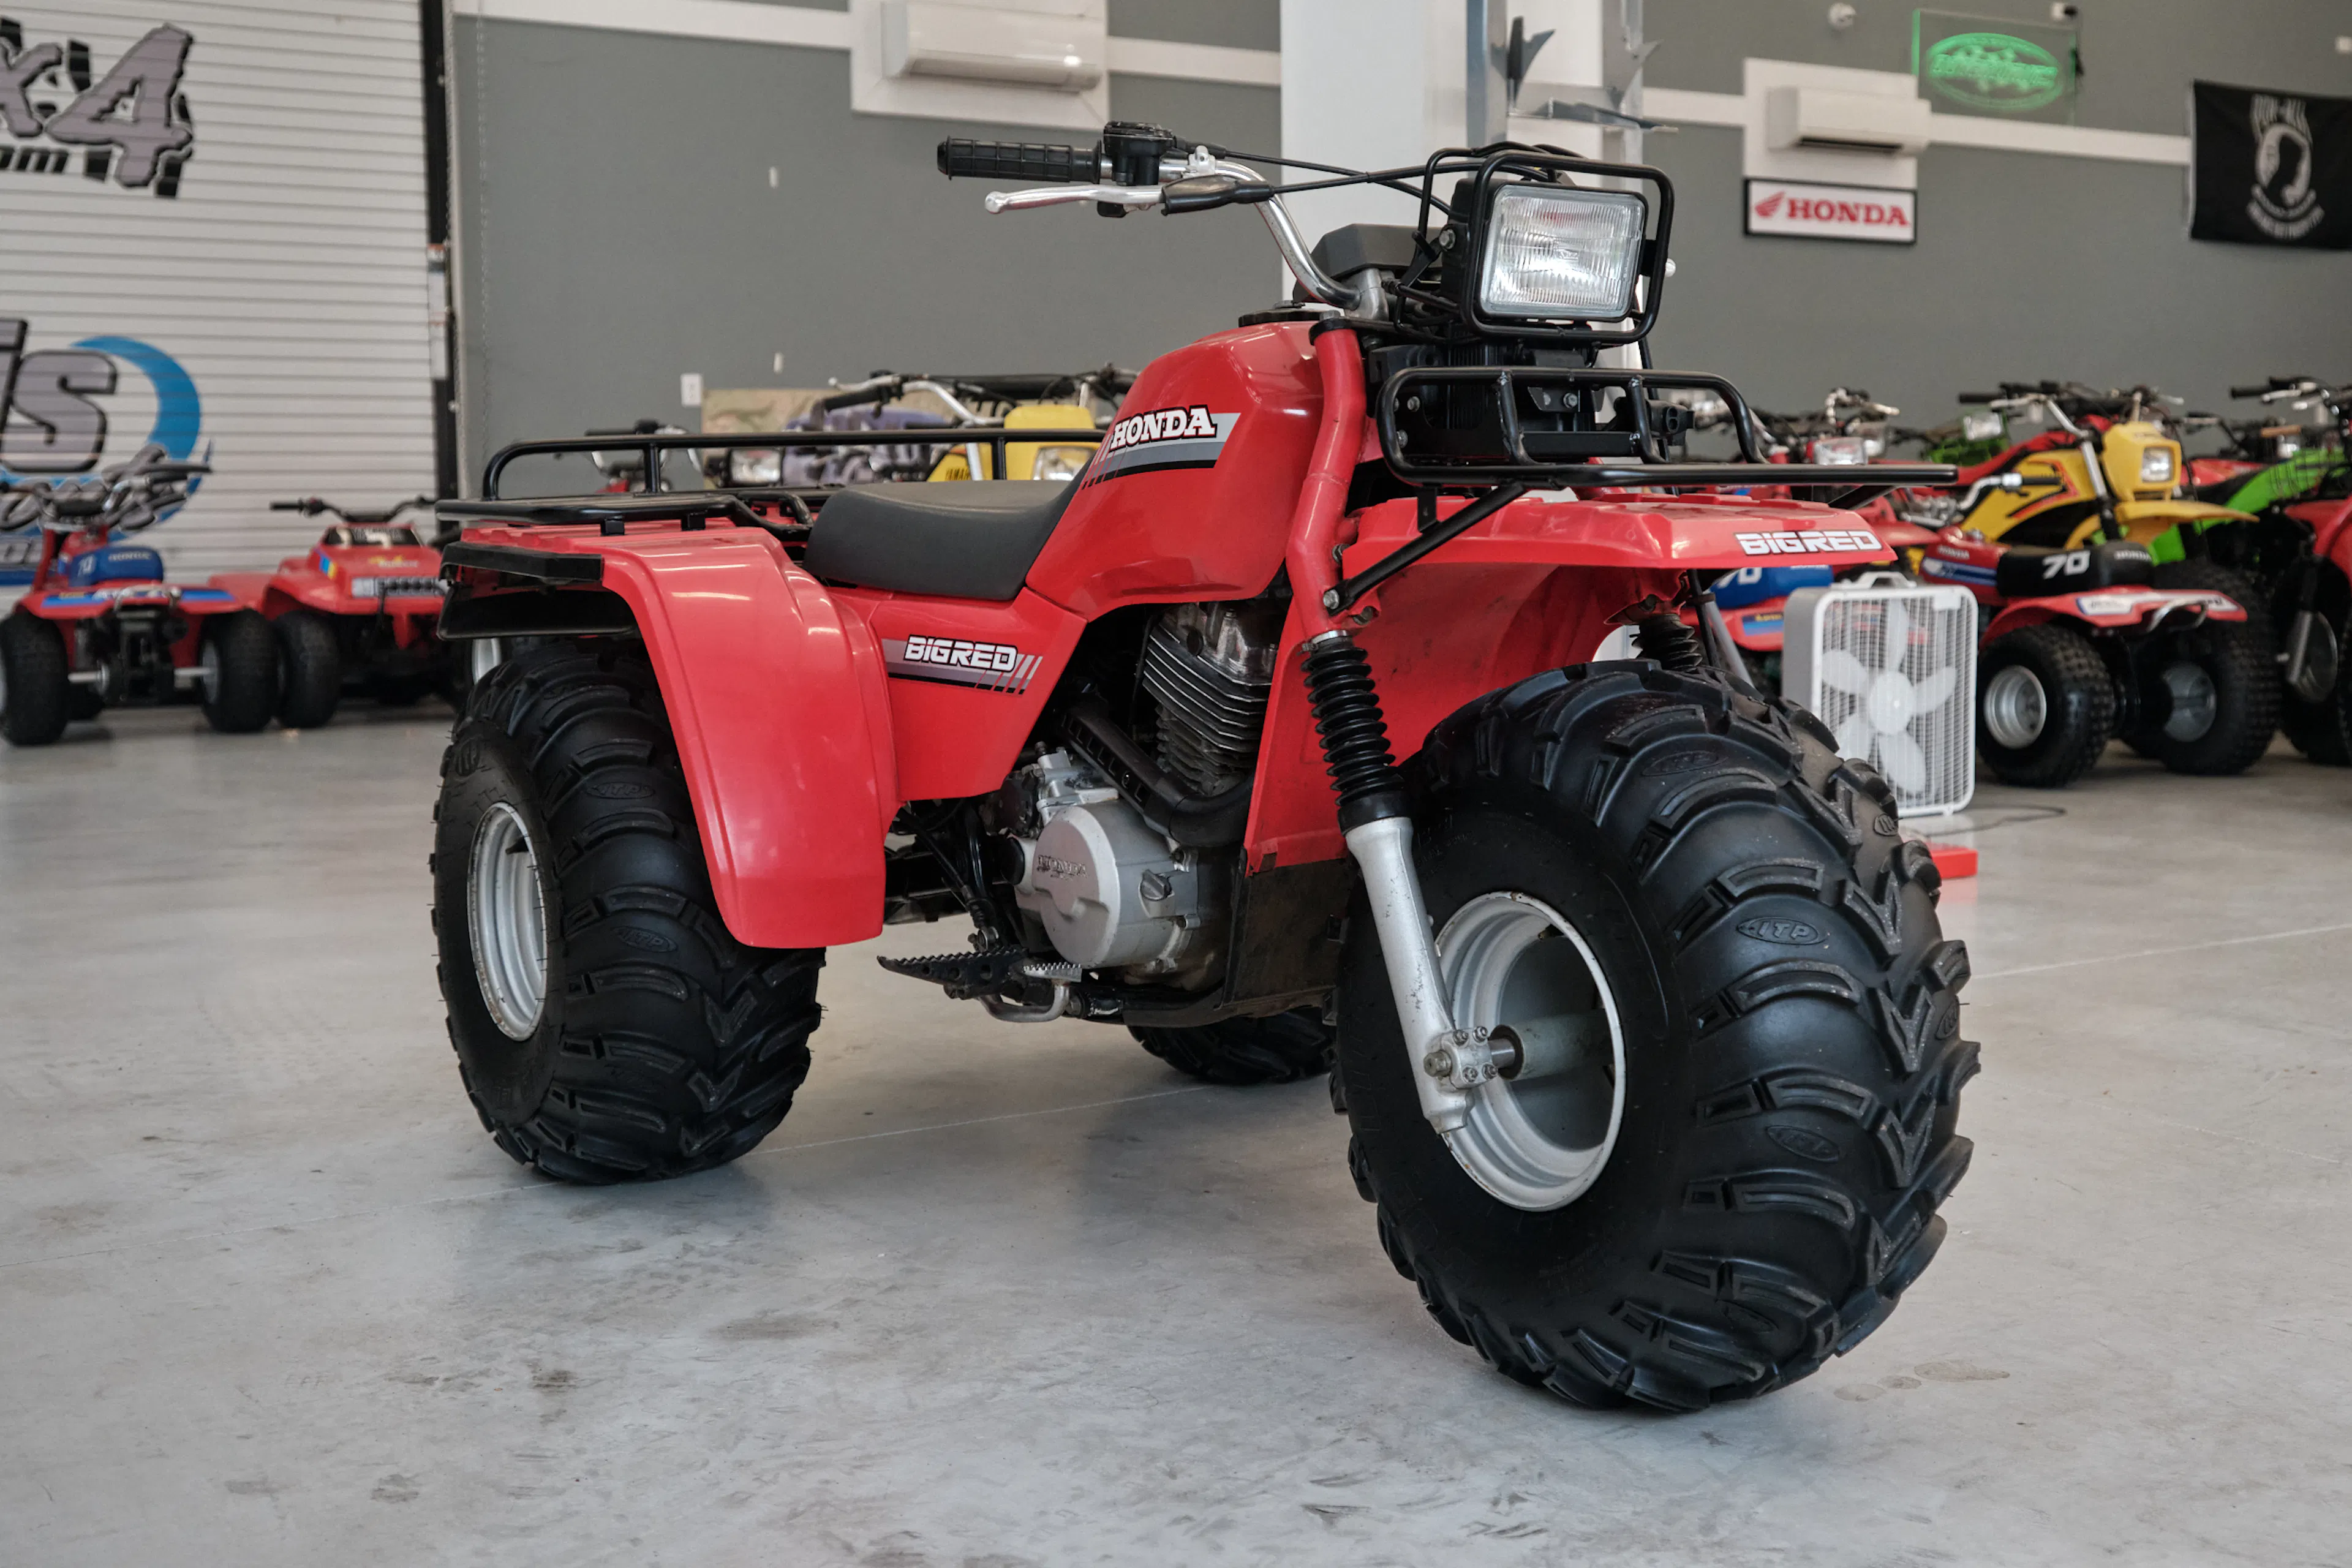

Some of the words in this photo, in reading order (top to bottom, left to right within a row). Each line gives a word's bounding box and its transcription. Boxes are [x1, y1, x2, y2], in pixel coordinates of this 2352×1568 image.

[1787, 197, 1909, 227] HONDA
[1109, 404, 1218, 452] HONDA
[2042, 550, 2090, 579] 70
[1036, 854, 1088, 878] HONDA
[1757, 921, 1811, 940] ITP
